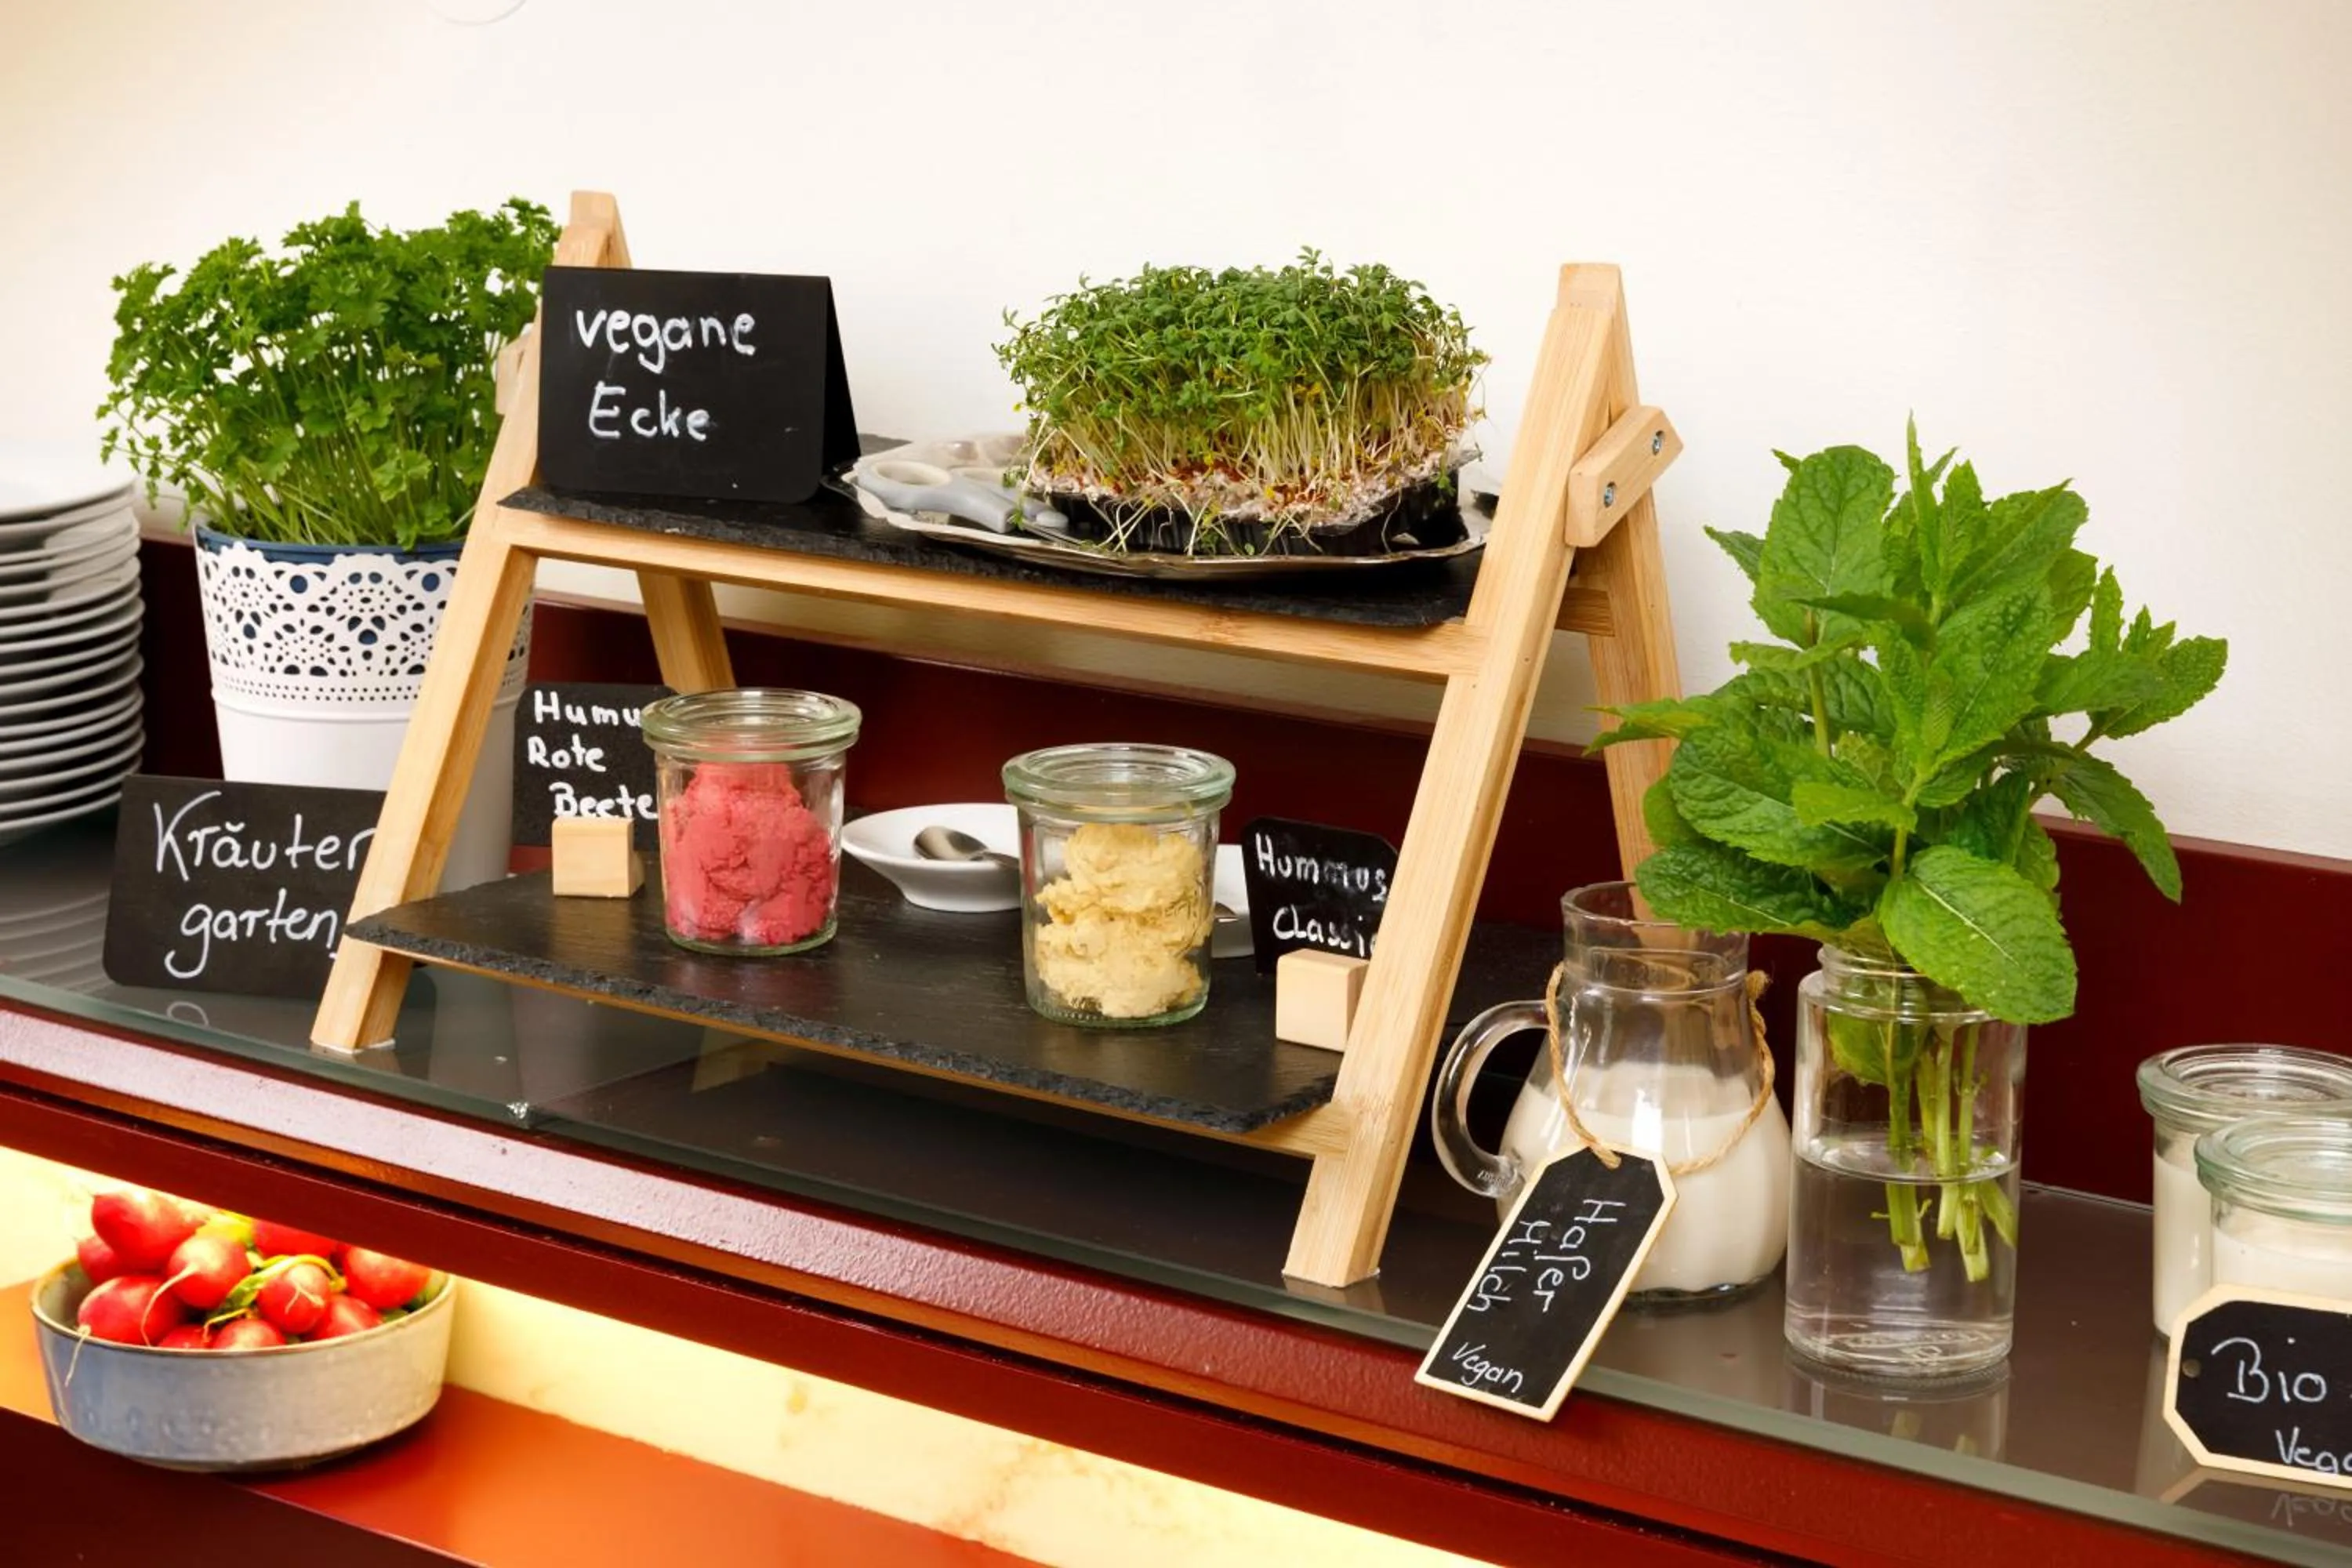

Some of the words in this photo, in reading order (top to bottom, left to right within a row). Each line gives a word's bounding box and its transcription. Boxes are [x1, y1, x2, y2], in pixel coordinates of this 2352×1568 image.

[575, 309, 756, 374] vegane
[588, 379, 712, 441] Ecke
[534, 689, 642, 728] Humu
[527, 733, 607, 772] Rote
[548, 781, 659, 820] Beete
[1533, 1198, 1627, 1314] Hafer
[1451, 1341, 1524, 1394] Vegan
[2210, 1336, 2328, 1404] Bio
